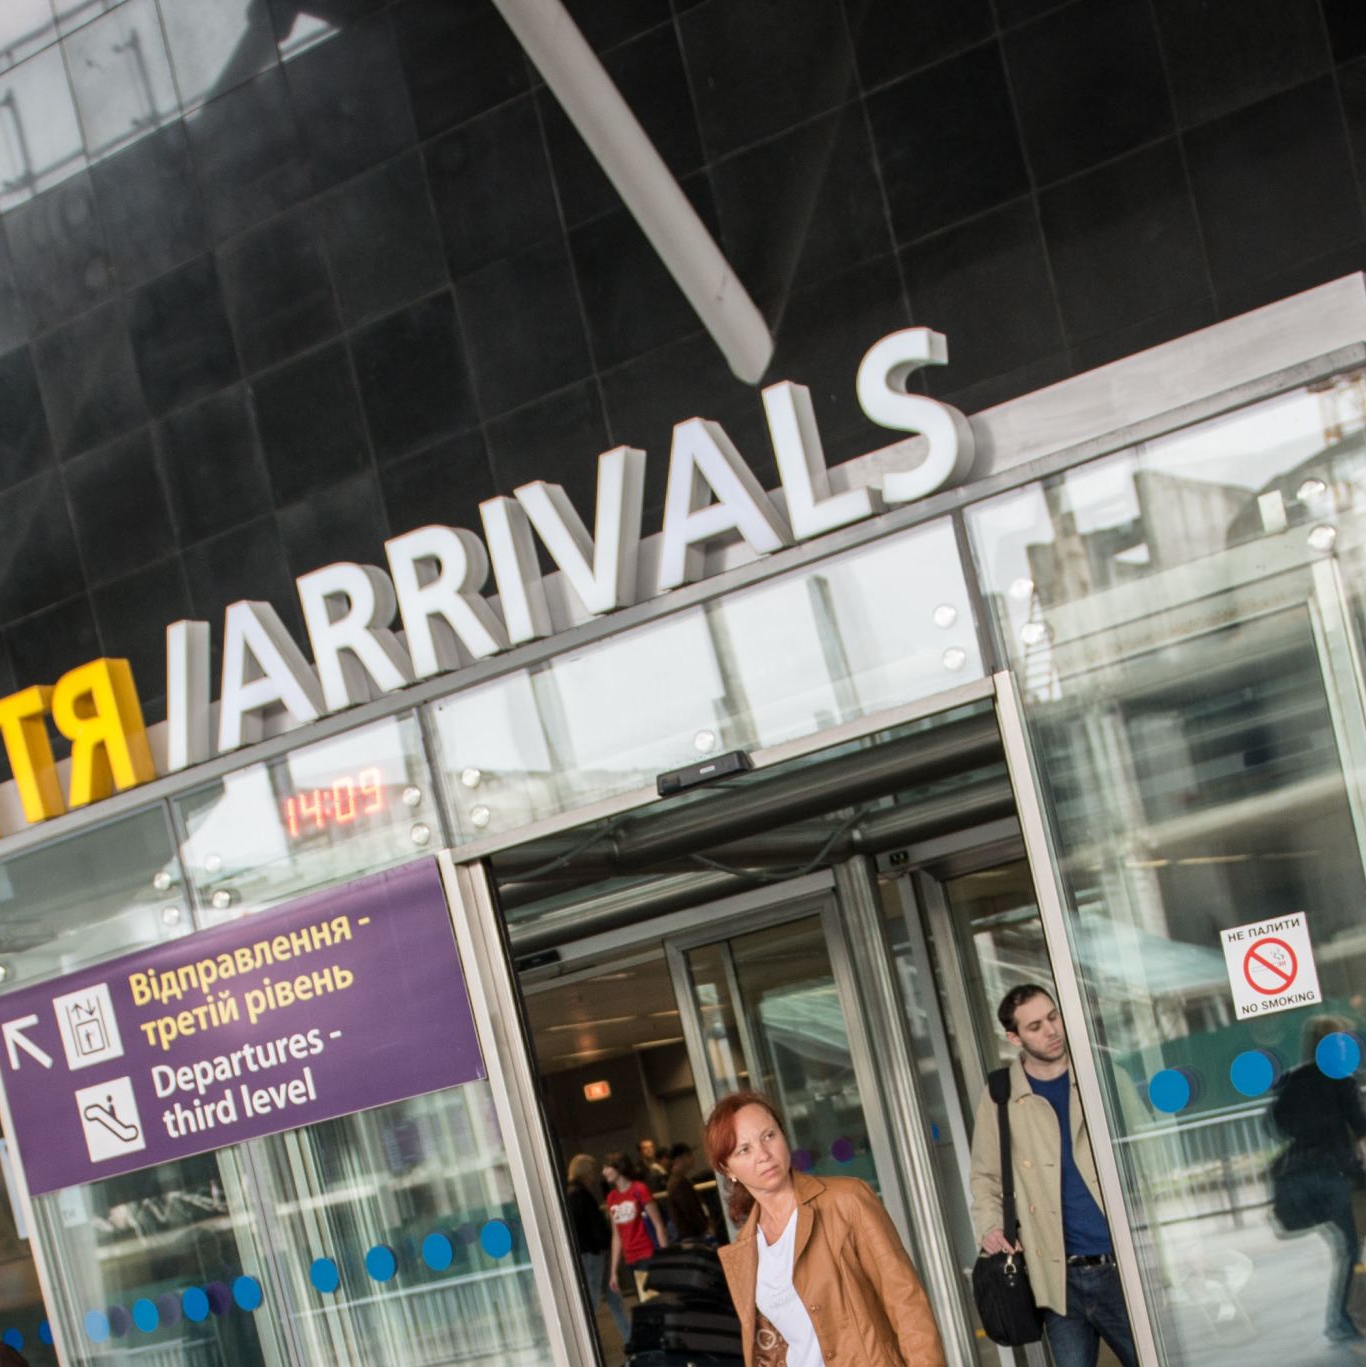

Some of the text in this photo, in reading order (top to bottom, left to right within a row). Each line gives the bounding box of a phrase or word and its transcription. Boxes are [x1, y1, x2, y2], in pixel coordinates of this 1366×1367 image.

[284, 767, 384, 837] 14:09
[129, 914, 352, 1006] Відправлення
[1227, 918, 1300, 943] НЕ ПАЛИТИ
[140, 965, 354, 1049] третій рівень
[1241, 991, 1315, 1014] NO SMOKING
[151, 1029, 325, 1099] Departures
[162, 1068, 318, 1139] third level
